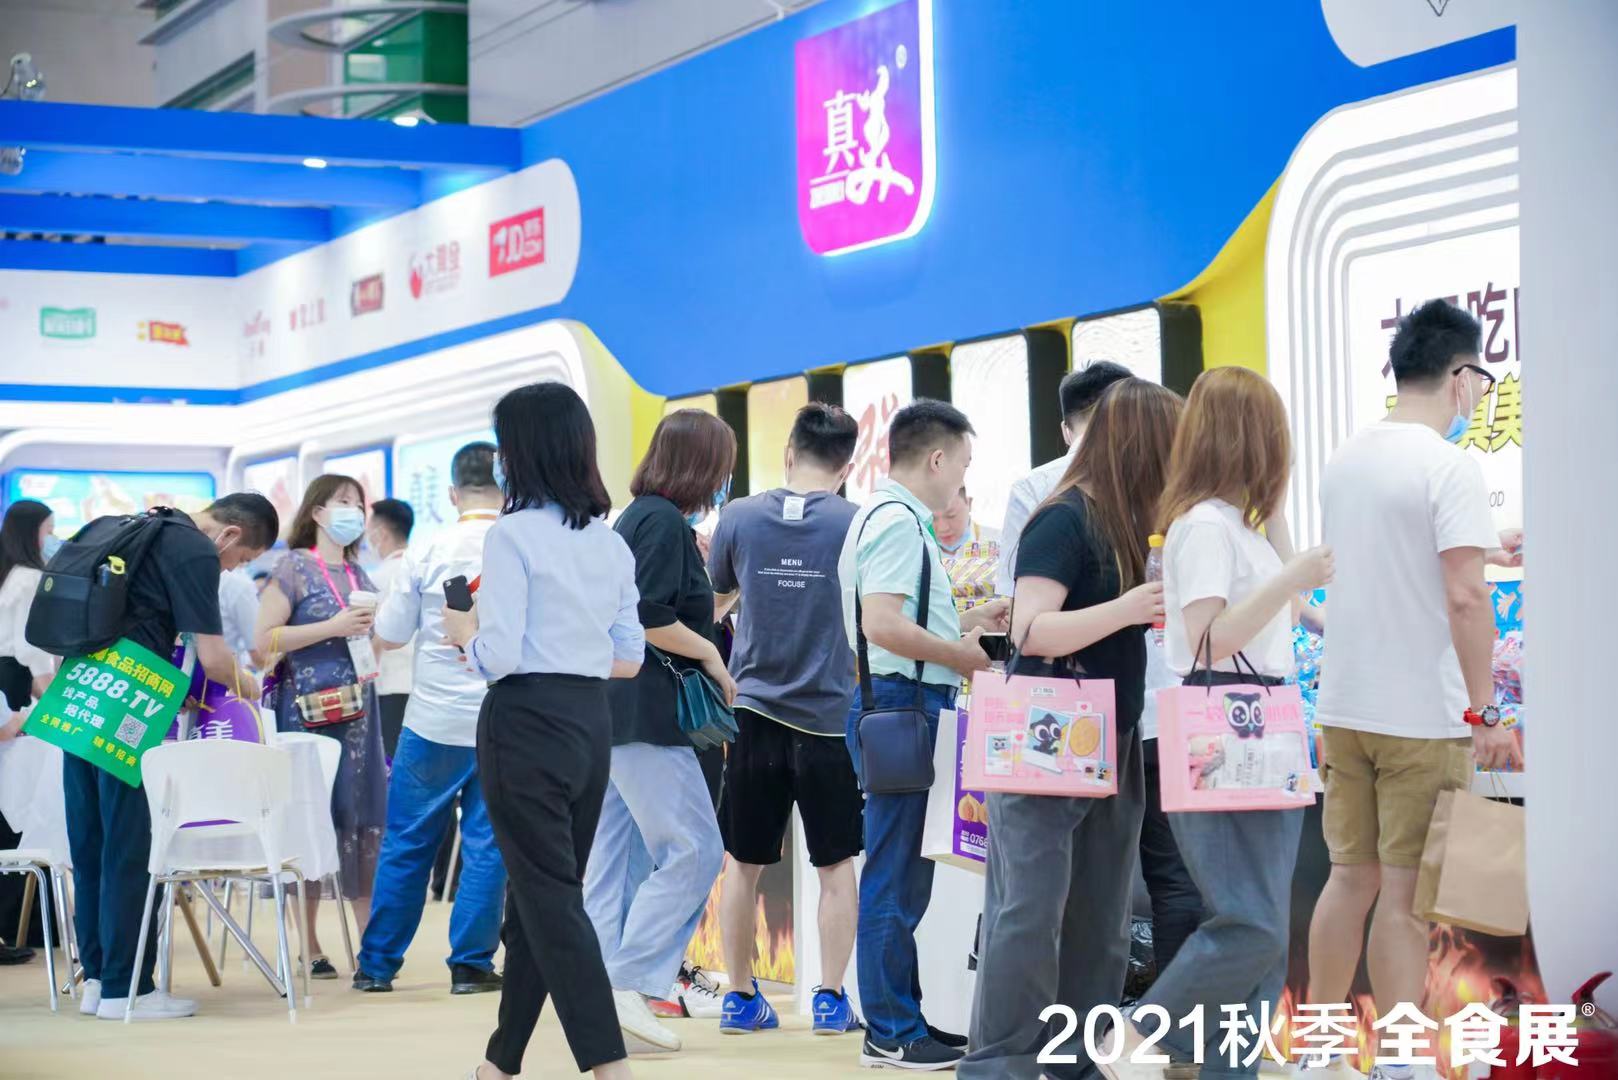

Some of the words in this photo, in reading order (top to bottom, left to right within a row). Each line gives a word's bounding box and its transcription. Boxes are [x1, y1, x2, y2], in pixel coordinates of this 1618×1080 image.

[781, 558, 803, 566] MENU
[777, 579, 806, 588] FOCUSE
[88, 647, 175, 699] 食品招商网
[61, 687, 100, 710] 找产品
[66, 662, 164, 719] 5888.TV
[63, 703, 106, 729] 招代理
